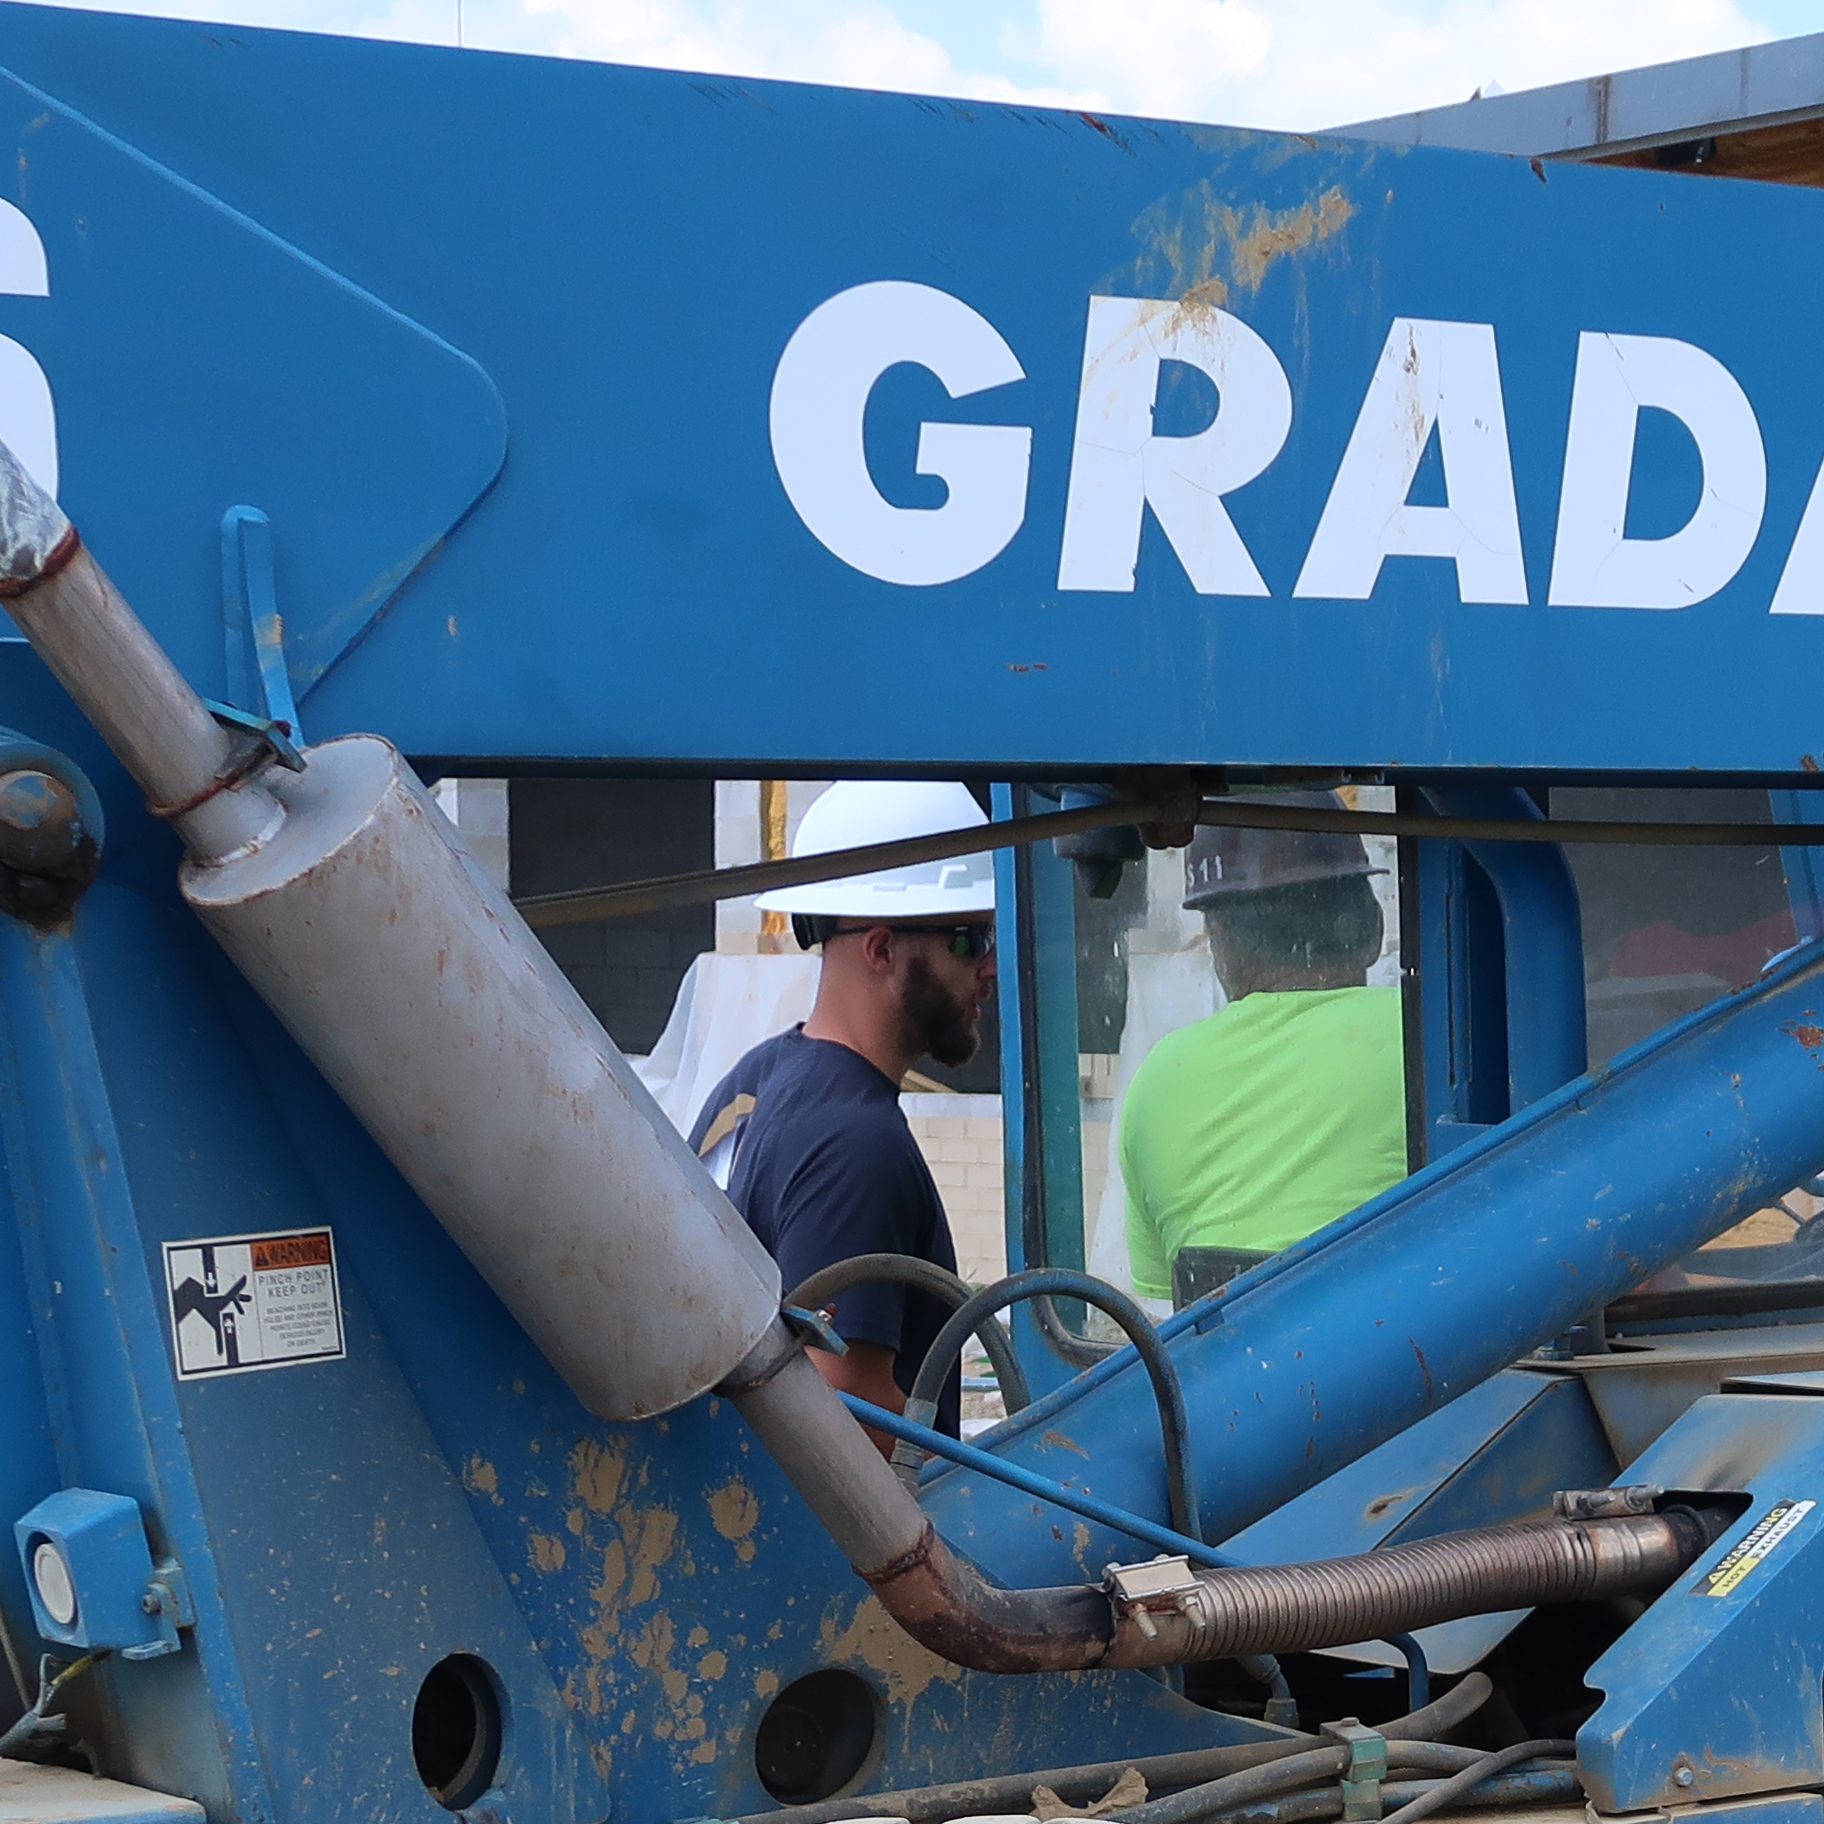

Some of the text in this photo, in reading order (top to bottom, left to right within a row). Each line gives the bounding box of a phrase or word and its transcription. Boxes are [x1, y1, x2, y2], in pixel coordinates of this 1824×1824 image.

[258, 1269, 328, 1285] PINCH POINT
[268, 1285, 296, 1298] KEEP
[1717, 1507, 1788, 1570] WARNING
[1722, 1508, 1803, 1588] HOT EXHAUST
